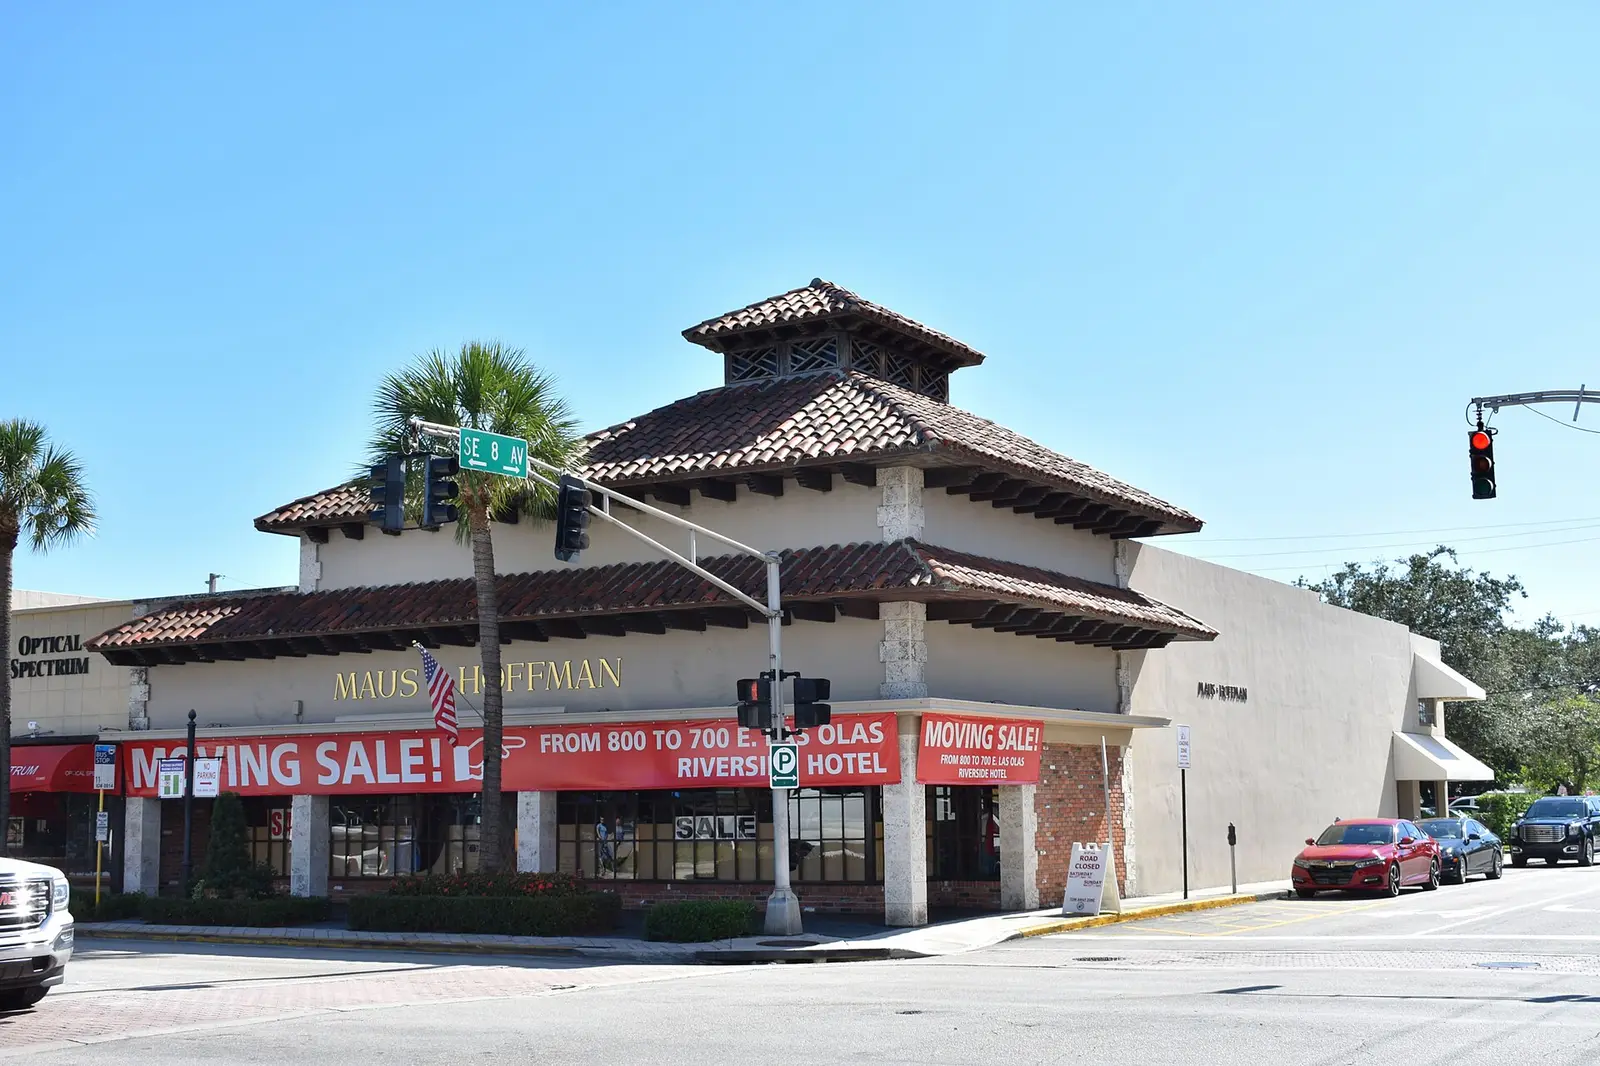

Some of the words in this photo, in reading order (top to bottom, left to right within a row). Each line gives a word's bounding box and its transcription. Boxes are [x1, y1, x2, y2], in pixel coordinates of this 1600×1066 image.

[463, 436, 480, 458] SE
[491, 441, 499, 461] 8
[510, 446, 524, 465] AV
[18, 634, 82, 656] OPTICAL
[10, 657, 89, 679] SPECTRUM
[333, 668, 419, 700] MAUS
[540, 731, 601, 753] FROM
[607, 730, 647, 751] 800
[652, 729, 682, 750] TO
[688, 727, 730, 749] 700
[737, 727, 757, 748] E.
[818, 721, 884, 745] OLAS
[924, 720, 994, 750] MOVING
[997, 724, 1040, 751] SALE!
[131, 742, 301, 789] MING
[315, 737, 442, 786] SALE!
[677, 755, 771, 778] RIVERSI
[807, 752, 888, 775] HOTEL
[779, 752, 791, 770] P
[940, 754, 959, 765] FROM
[959, 755, 971, 766] 800
[972, 755, 980, 766] TO
[981, 756, 991, 766] 700
[998, 756, 1009, 766] LAS
[1010, 757, 1025, 767] OLAS
[196, 771, 216, 780] PARKING
[958, 768, 989, 779] RIVERSIDE
[990, 769, 1007, 779] HOTEL
[676, 817, 756, 839] SALE
